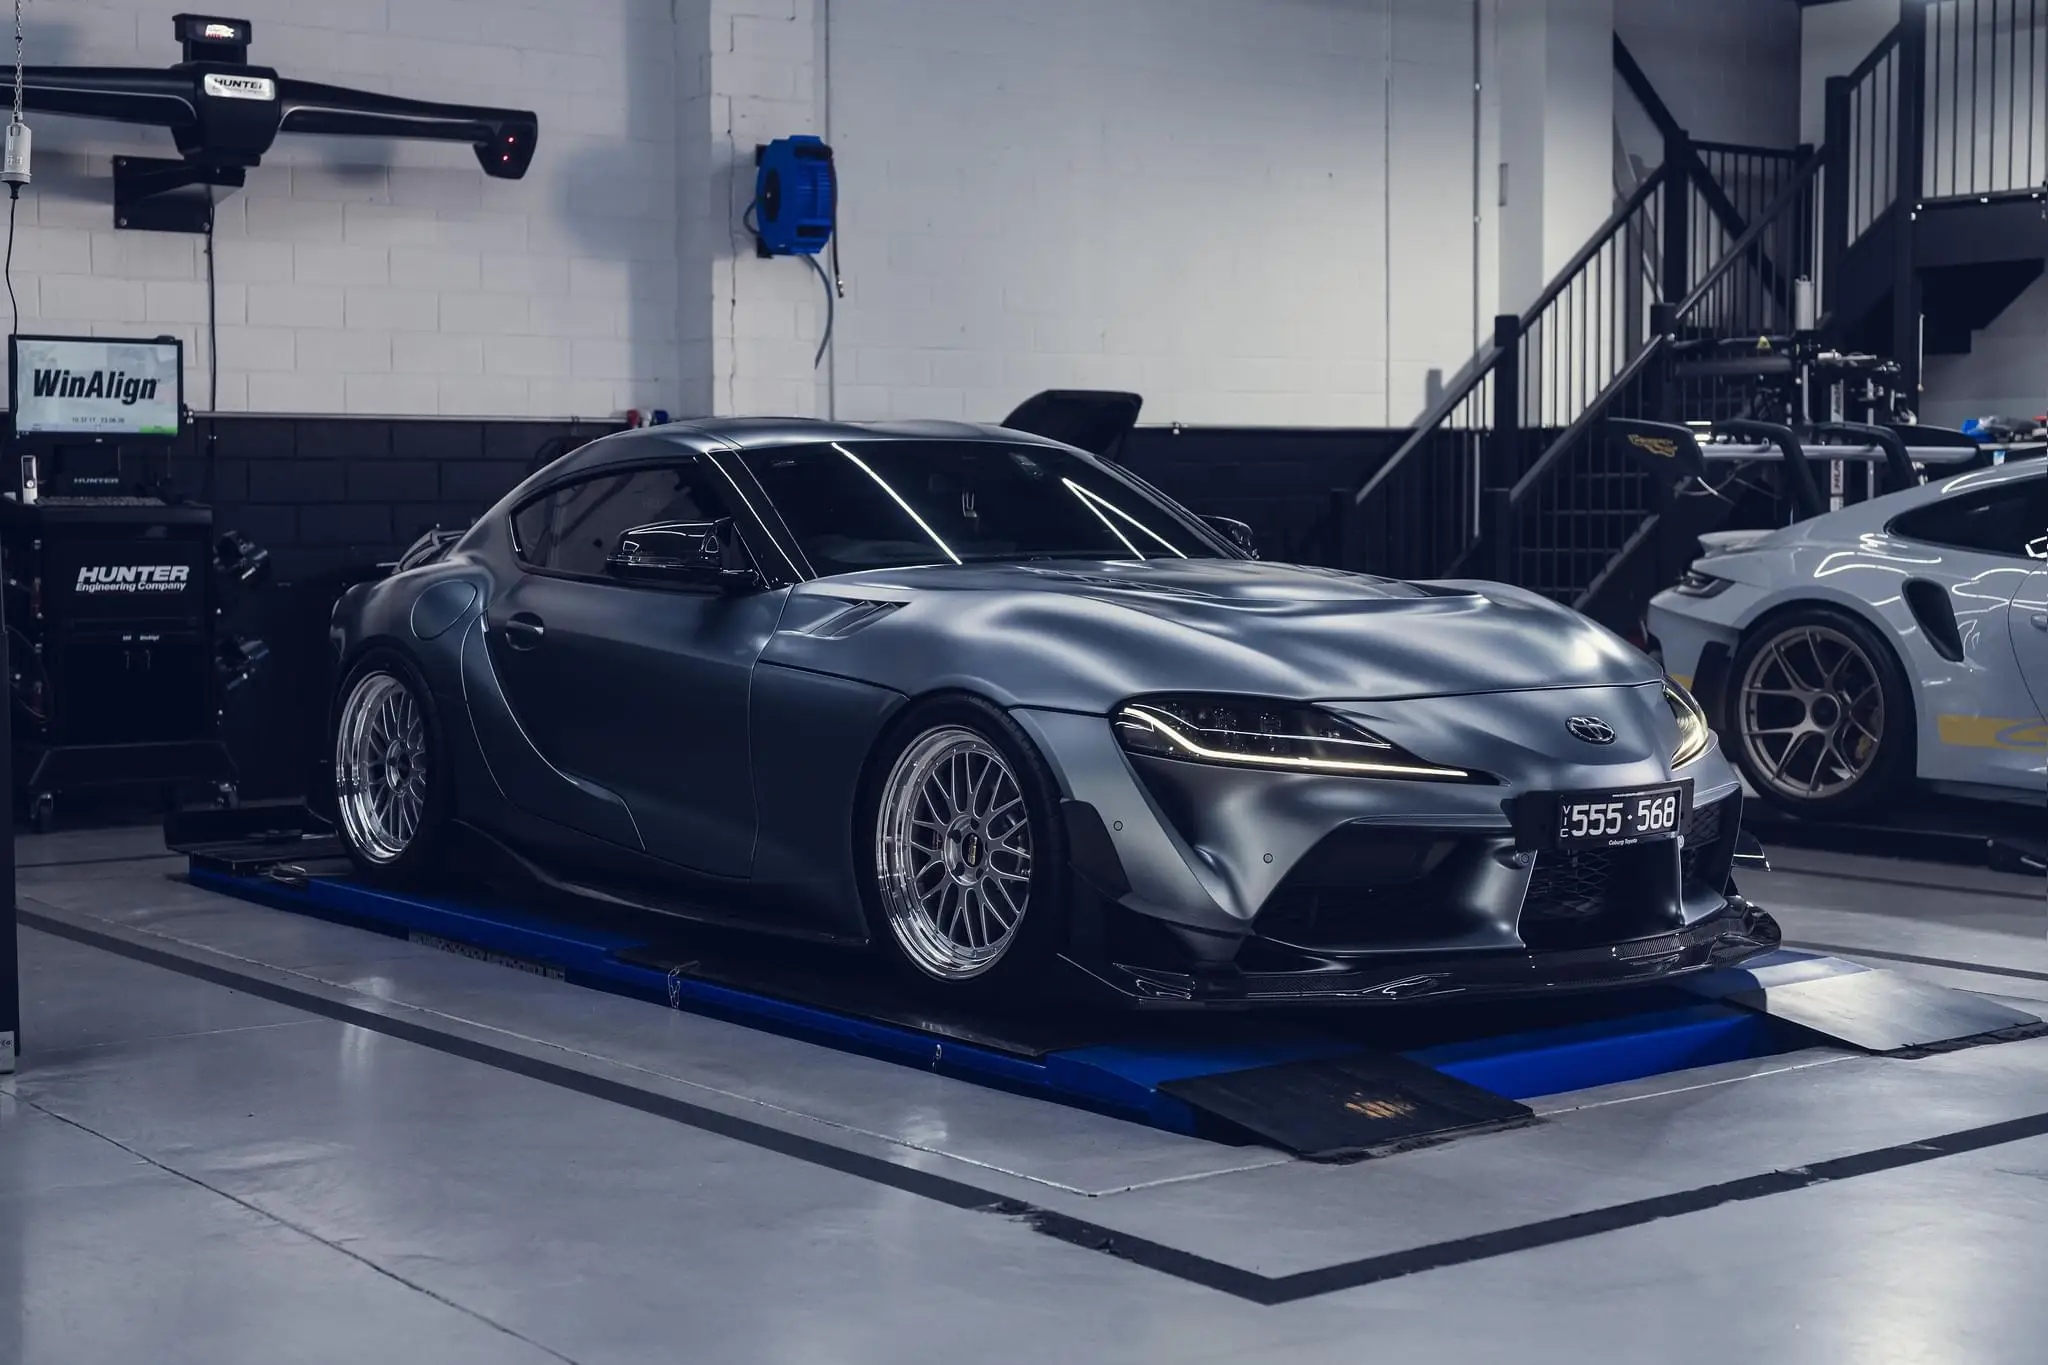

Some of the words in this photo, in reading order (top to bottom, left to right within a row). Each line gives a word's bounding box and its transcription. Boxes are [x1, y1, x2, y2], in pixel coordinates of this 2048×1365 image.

[33, 368, 158, 405] WinAlign
[77, 565, 190, 582] HUNTER
[75, 582, 137, 593] Engineering
[137, 582, 187, 592] Company
